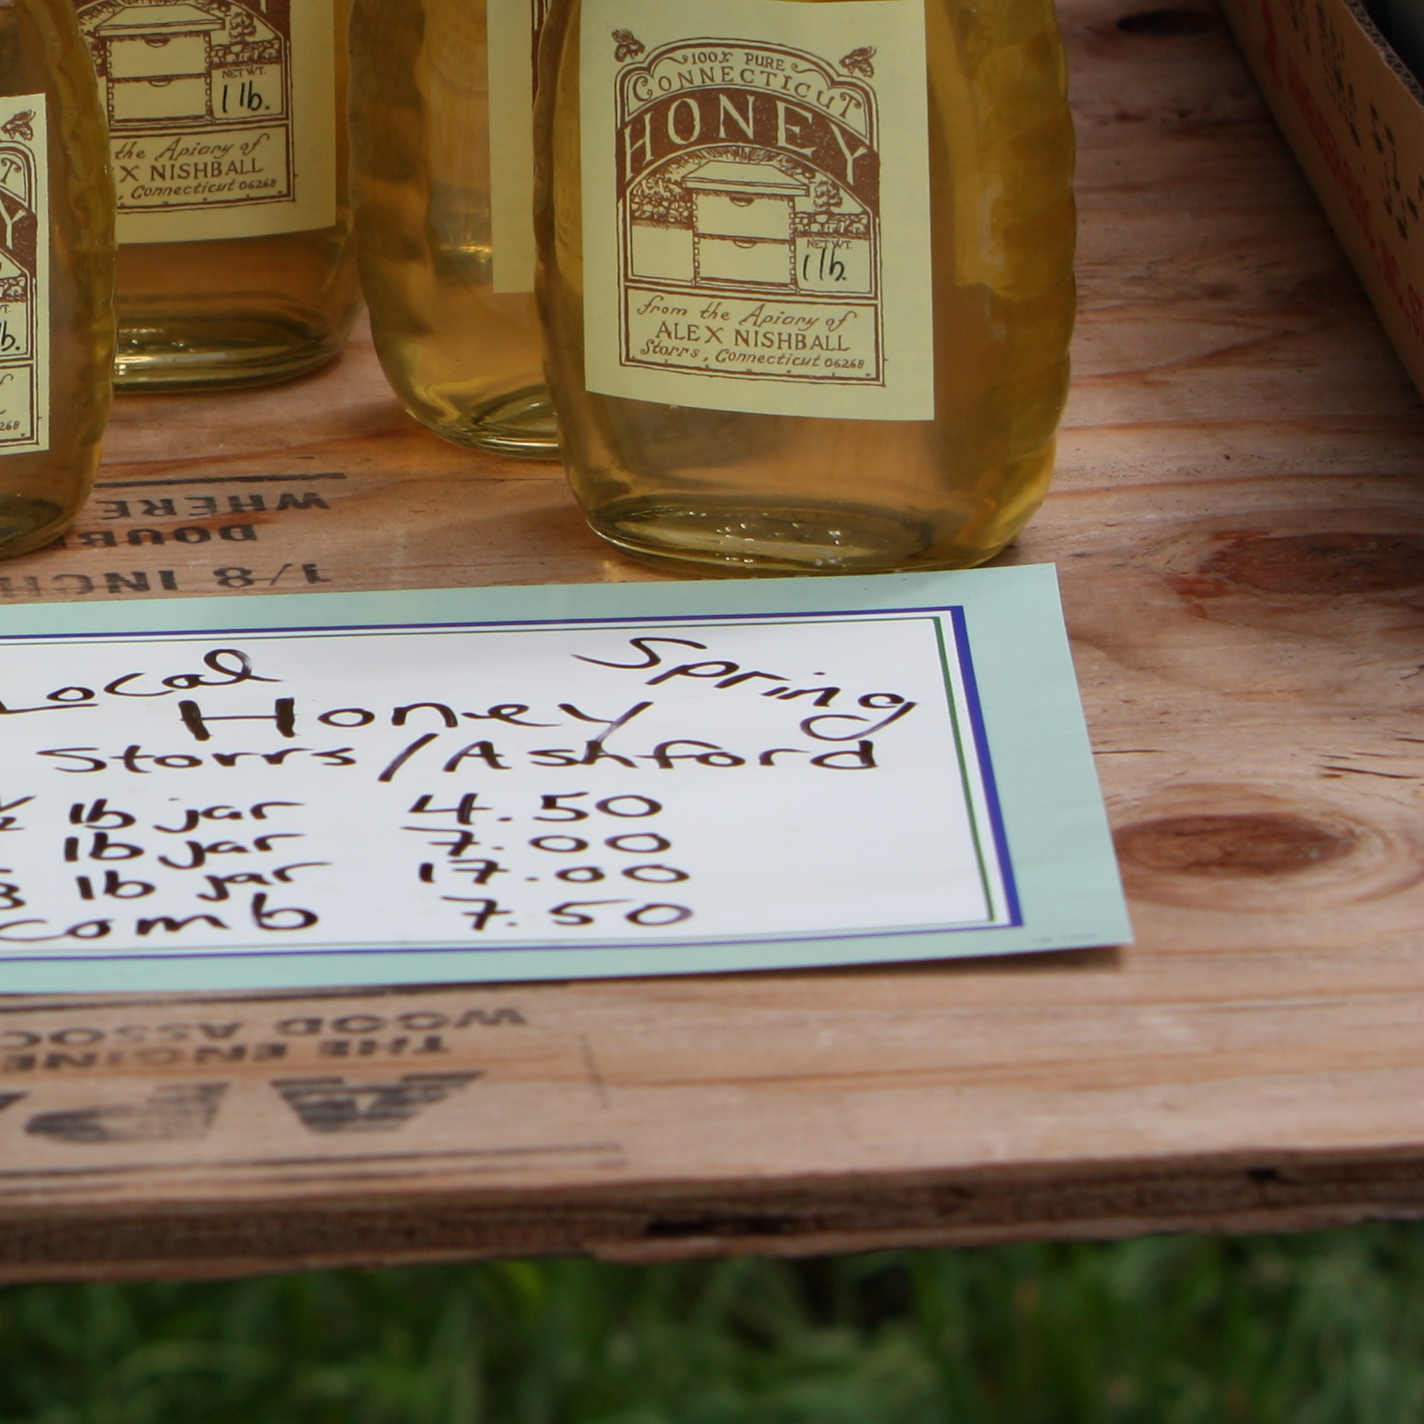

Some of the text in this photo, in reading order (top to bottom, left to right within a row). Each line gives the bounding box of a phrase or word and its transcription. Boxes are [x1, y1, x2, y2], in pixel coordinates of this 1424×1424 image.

[222, 70, 244, 78] NET
[744, 52, 786, 71] PURE
[633, 66, 862, 119] CONNECTICUT
[114, 133, 270, 161] the Apiary of
[625, 93, 869, 186] HONEY
[150, 158, 264, 182] NISHBALL
[131, 179, 276, 199] Connecticut 06268
[807, 240, 828, 249] NET
[637, 295, 857, 331] from the Apiary of
[655, 321, 851, 352] ALEX NISHBALL
[715, 348, 821, 367] Connecticut
[824, 358, 864, 369] 06268
[97, 493, 330, 520] WHERE
[60, 523, 259, 547] DOUB
[0, 569, 178, 598] INCH
[213, 563, 336, 587] 1/8
[179, 698, 655, 744] Honey
[571, 636, 918, 742] Spring
[153, 798, 305, 833] jar
[408, 792, 662, 825] 4.50
[158, 833, 306, 869] jar
[401, 826, 672, 856] 7.00
[196, 862, 333, 901] jar
[418, 860, 690, 885] 17.00
[440, 897, 694, 931] 7.50
[276, 1006, 526, 1036] WOOD
[326, 1035, 453, 1057] THE
